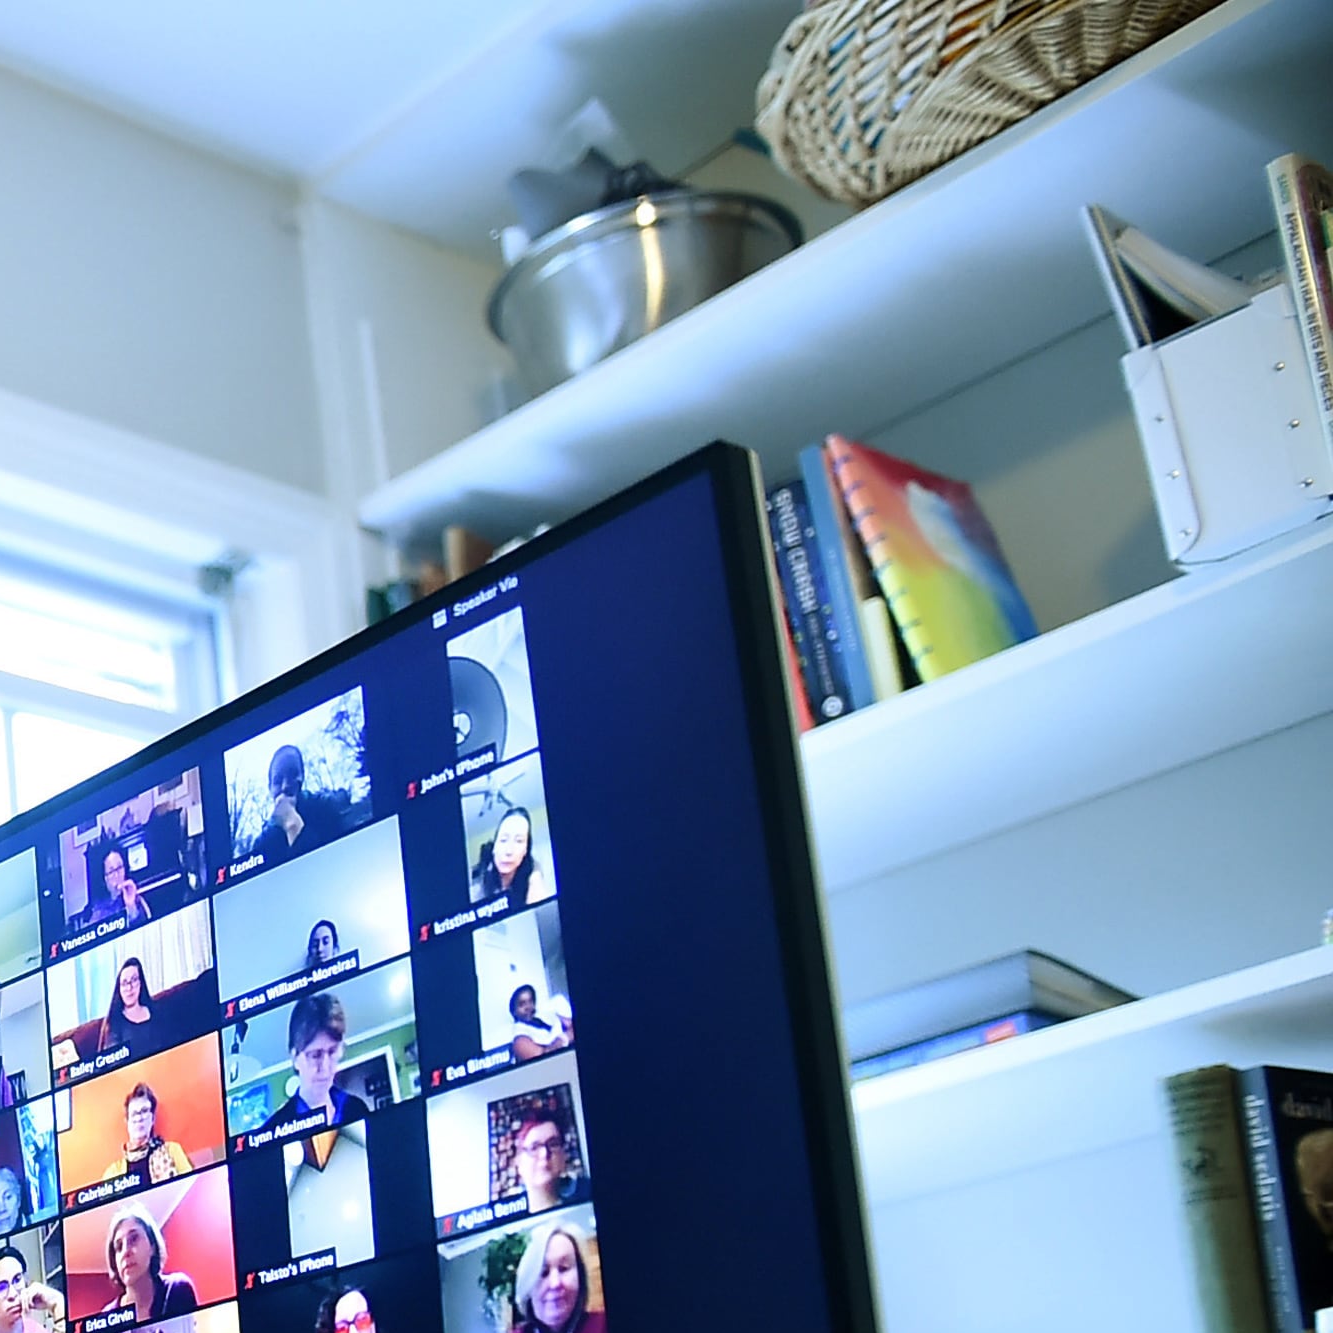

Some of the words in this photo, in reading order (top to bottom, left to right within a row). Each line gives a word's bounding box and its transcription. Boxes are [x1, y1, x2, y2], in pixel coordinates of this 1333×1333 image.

[1300, 281, 1316, 312] TRAIL
[1306, 312, 1319, 326] IN
[1309, 324, 1325, 350] BITS
[1315, 350, 1329, 373] AND
[1319, 372, 1333, 412] PIECES
[452, 586, 497, 617] Speaker
[420, 767, 455, 794] John's
[455, 748, 495, 778] iPhone
[229, 852, 264, 877] Kendra
[433, 910, 476, 936] kristina
[477, 895, 509, 920] wyatt
[60, 929, 96, 952] Vanessa
[96, 915, 125, 937] Chang
[239, 993, 266, 1012] Elena
[70, 1060, 95, 1080] Bailey
[95, 1046, 130, 1068] Greseth
[445, 1066, 466, 1081] Eva
[248, 1130, 272, 1148] Lynn
[273, 1112, 325, 1140] Adelmann
[1244, 1095, 1272, 1148] david
[77, 1183, 113, 1204] Gabriele
[1254, 1151, 1282, 1222] sedaris
[299, 1253, 334, 1274] iPhone
[85, 1317, 107, 1333] Erica
